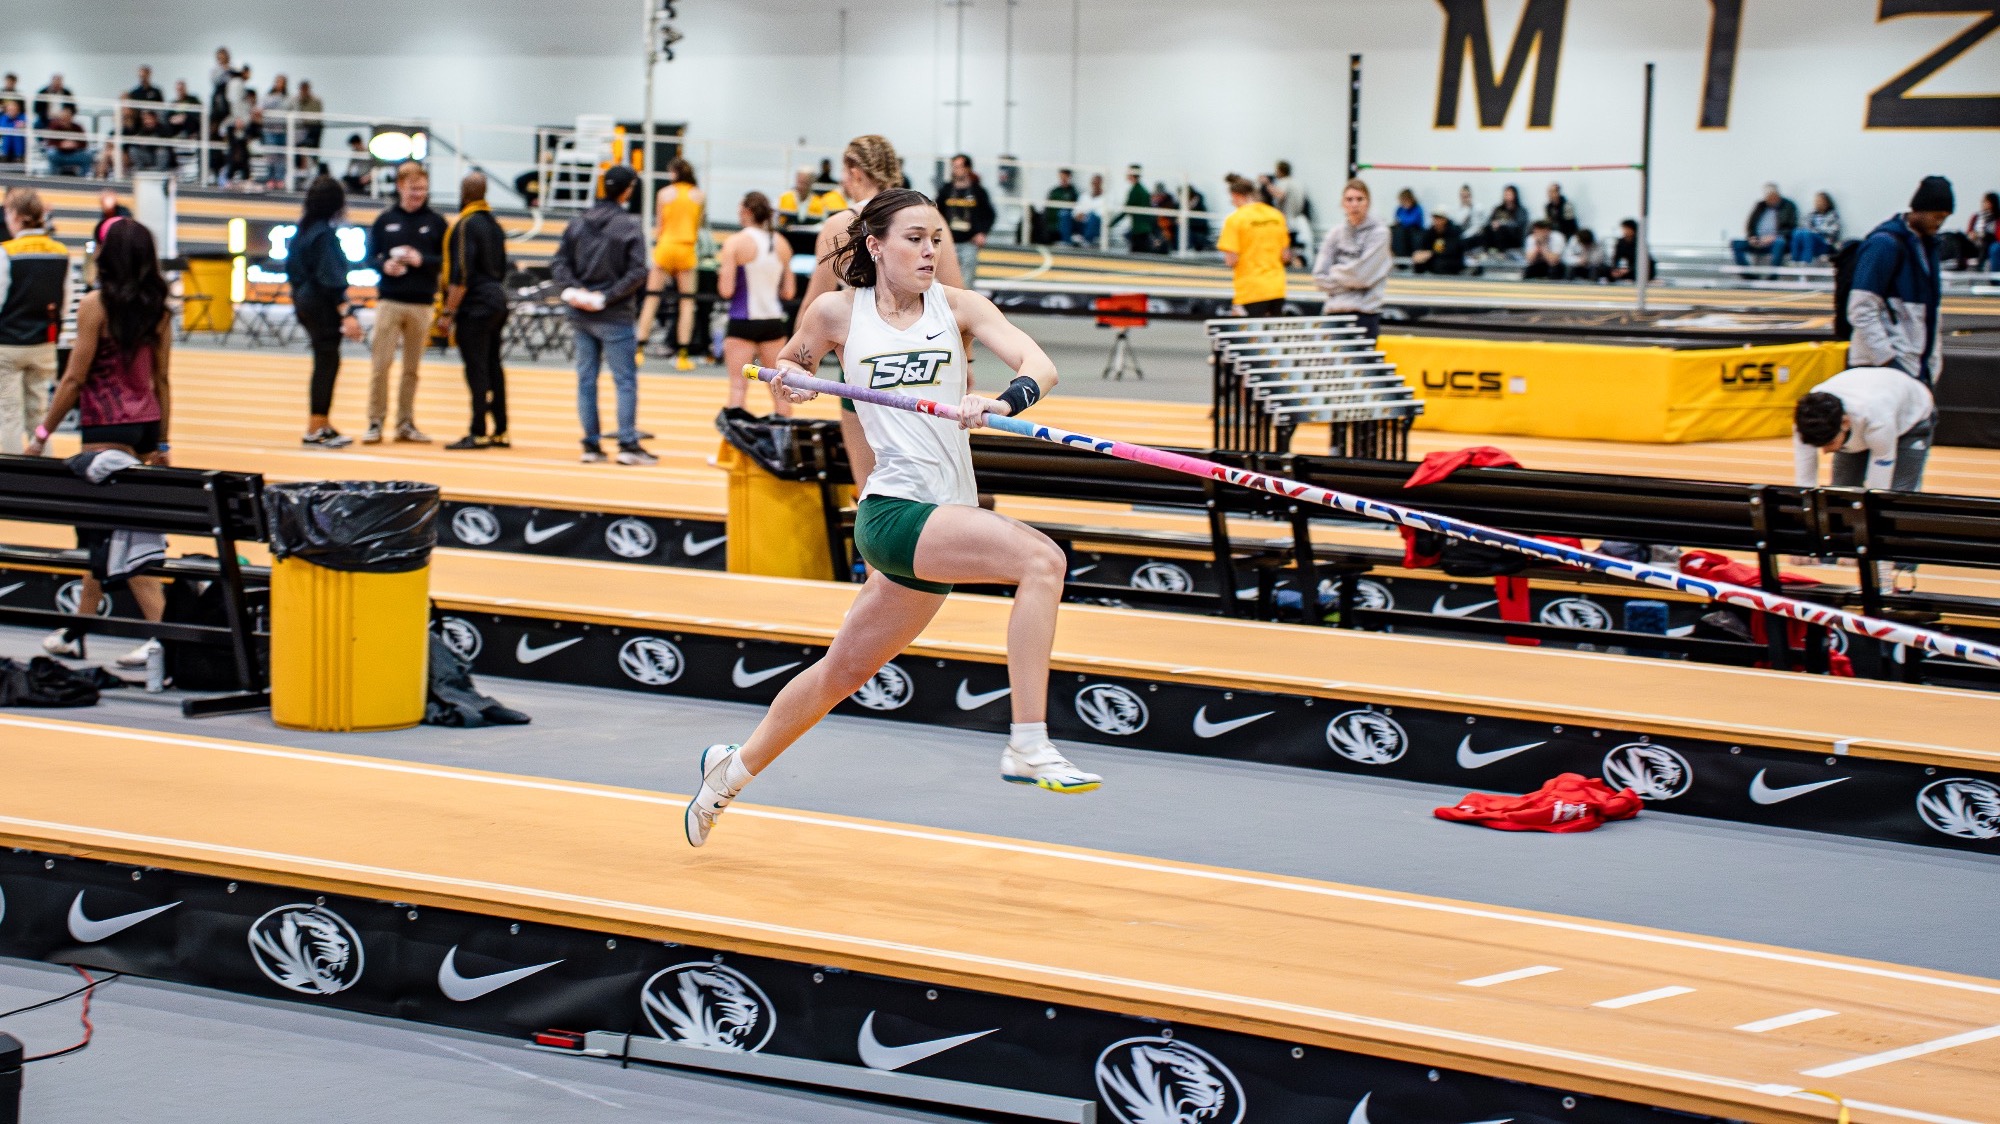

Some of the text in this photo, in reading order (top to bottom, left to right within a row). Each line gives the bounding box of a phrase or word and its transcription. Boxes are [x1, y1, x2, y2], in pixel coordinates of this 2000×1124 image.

[863, 350, 952, 389] S&T
[1421, 369, 1503, 392] UCS
[1720, 361, 1776, 385] UCS
